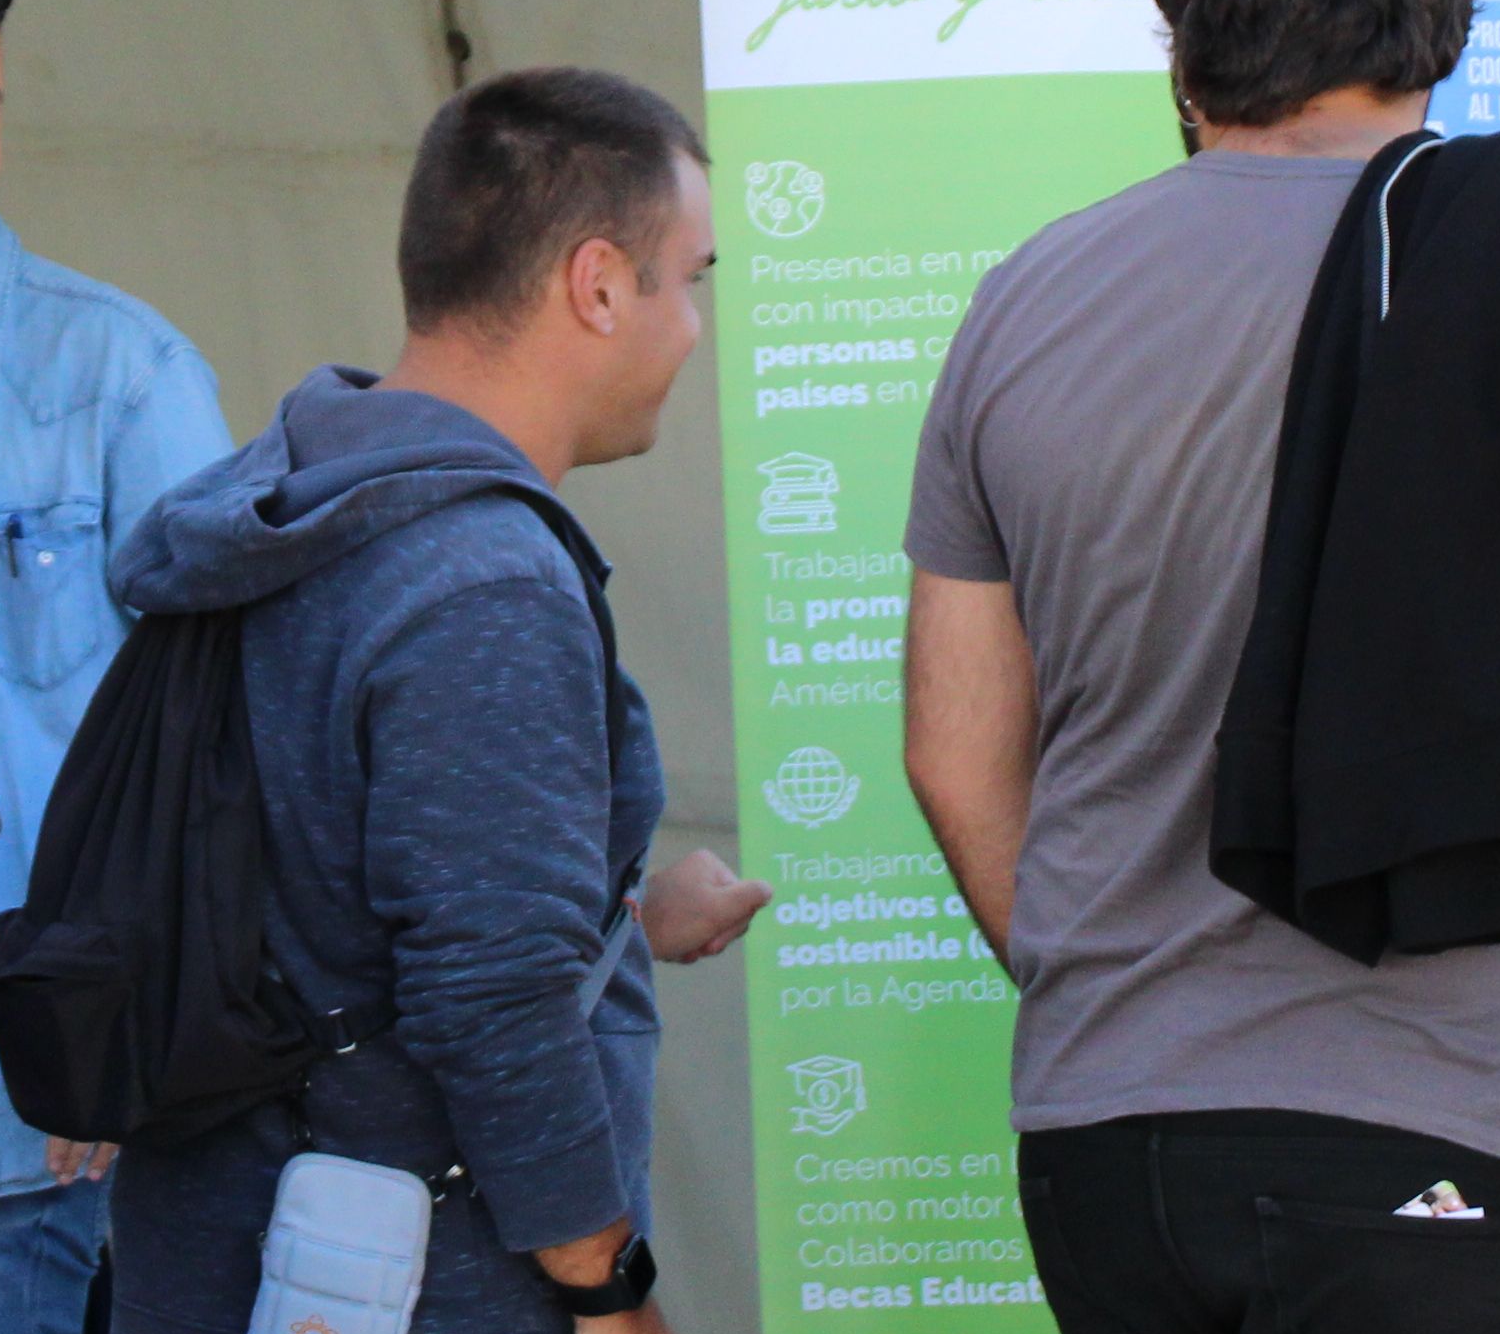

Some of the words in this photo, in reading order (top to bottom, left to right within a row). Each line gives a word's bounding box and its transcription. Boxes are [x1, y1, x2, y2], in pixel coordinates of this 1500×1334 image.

[1468, 92, 1495, 120] AL
[751, 248, 911, 283] Presencia
[919, 250, 961, 275] en
[752, 301, 814, 326] con
[823, 289, 959, 328] impacto
[754, 337, 916, 375] personas
[756, 378, 869, 418] países
[875, 379, 919, 403] en
[765, 593, 796, 623] la
[805, 595, 904, 629] prom
[766, 636, 803, 665] la
[811, 632, 904, 663] educ
[773, 848, 947, 885] Trabajamo
[775, 891, 937, 931] objetivos
[777, 931, 962, 967] sostenible
[781, 985, 836, 1018] por
[843, 977, 873, 1007] la
[879, 971, 1006, 1012] Agenda
[795, 1153, 952, 1184] Creemos
[960, 1152, 1001, 1177] en
[796, 1199, 897, 1226] como
[906, 1190, 1005, 1220] motor
[798, 1235, 1024, 1268] Colaboramos
[801, 1281, 913, 1312] Becas
[920, 1275, 1046, 1306] Educat
